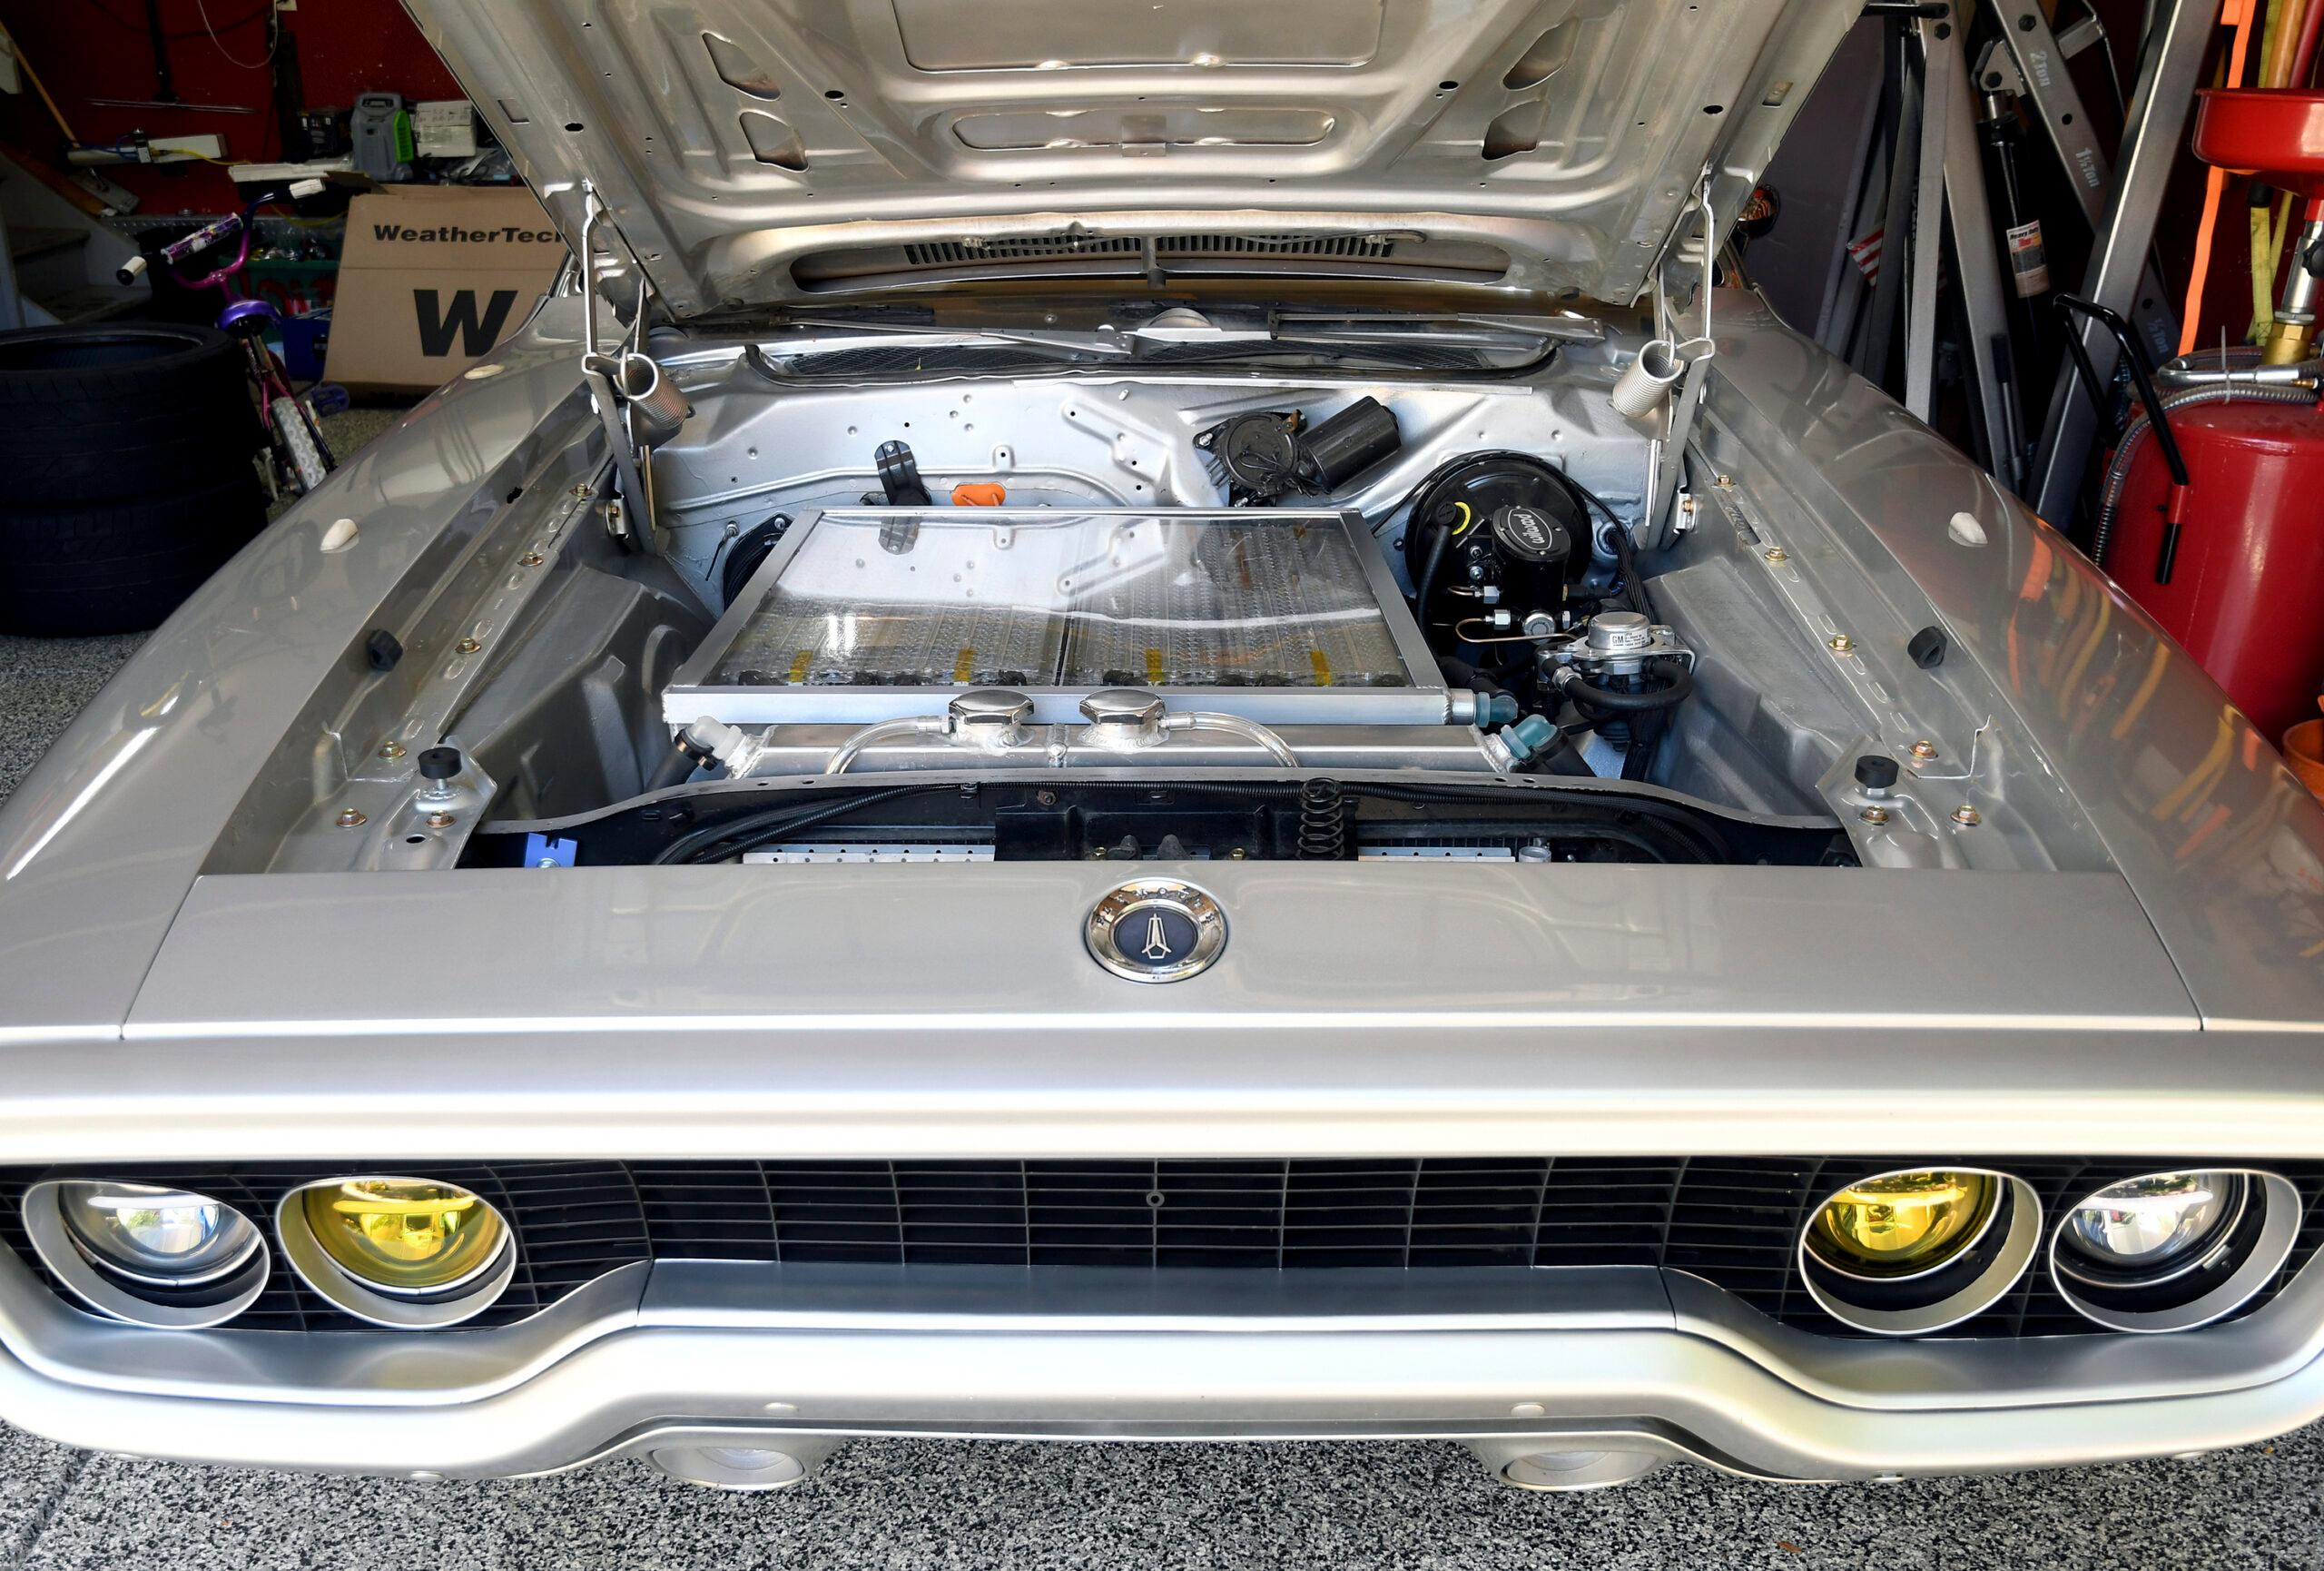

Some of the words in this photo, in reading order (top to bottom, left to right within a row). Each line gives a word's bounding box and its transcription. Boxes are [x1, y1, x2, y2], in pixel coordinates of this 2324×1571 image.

[413, 289, 518, 357] W
[1512, 513, 1546, 544] wilwood
[1611, 635, 1624, 644] GM
